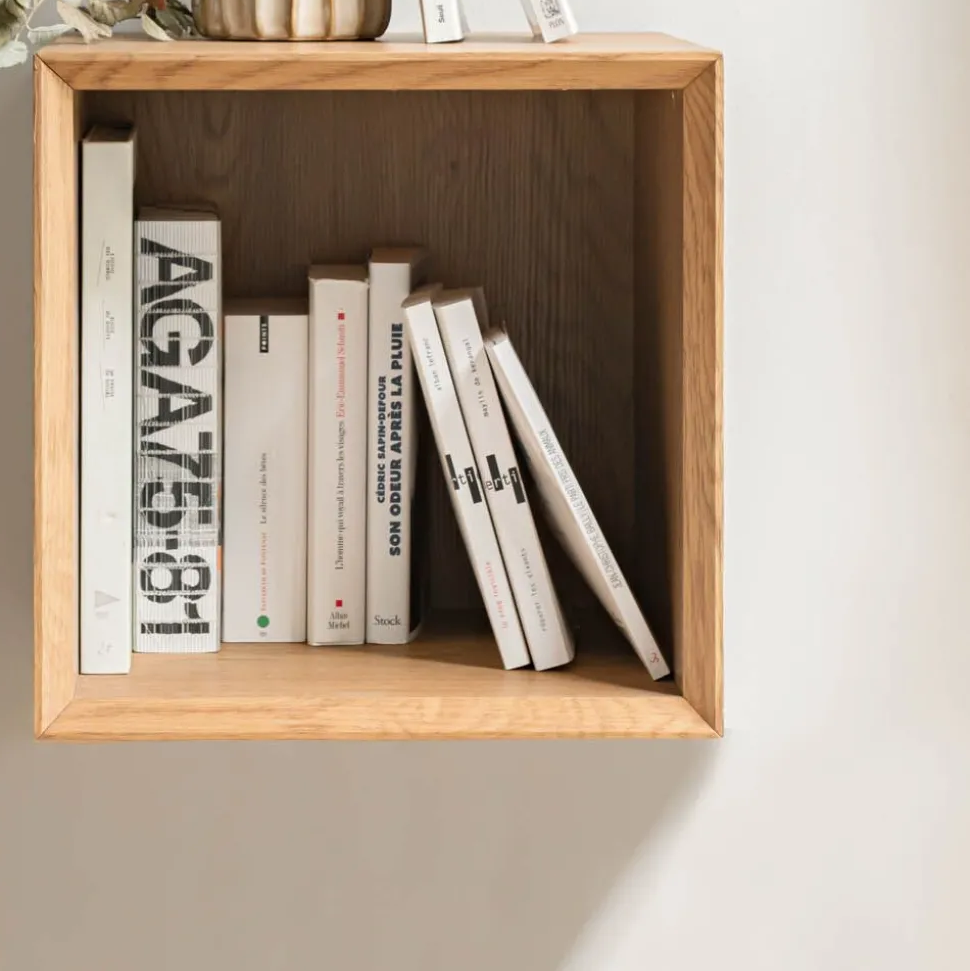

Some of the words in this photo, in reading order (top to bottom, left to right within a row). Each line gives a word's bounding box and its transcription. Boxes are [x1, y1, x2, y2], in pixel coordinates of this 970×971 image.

[391, 323, 403, 370] PLUIE
[390, 375, 402, 396] LA
[337, 420, 346, 449] visages
[378, 375, 386, 459] SAPIN-DEFOUR
[387, 401, 402, 454] APRÈS
[336, 450, 344, 461] les
[376, 463, 385, 503] CÉDRIC
[389, 458, 402, 516] ODEUR
[389, 521, 401, 556] SON
[374, 614, 401, 626] Stock
